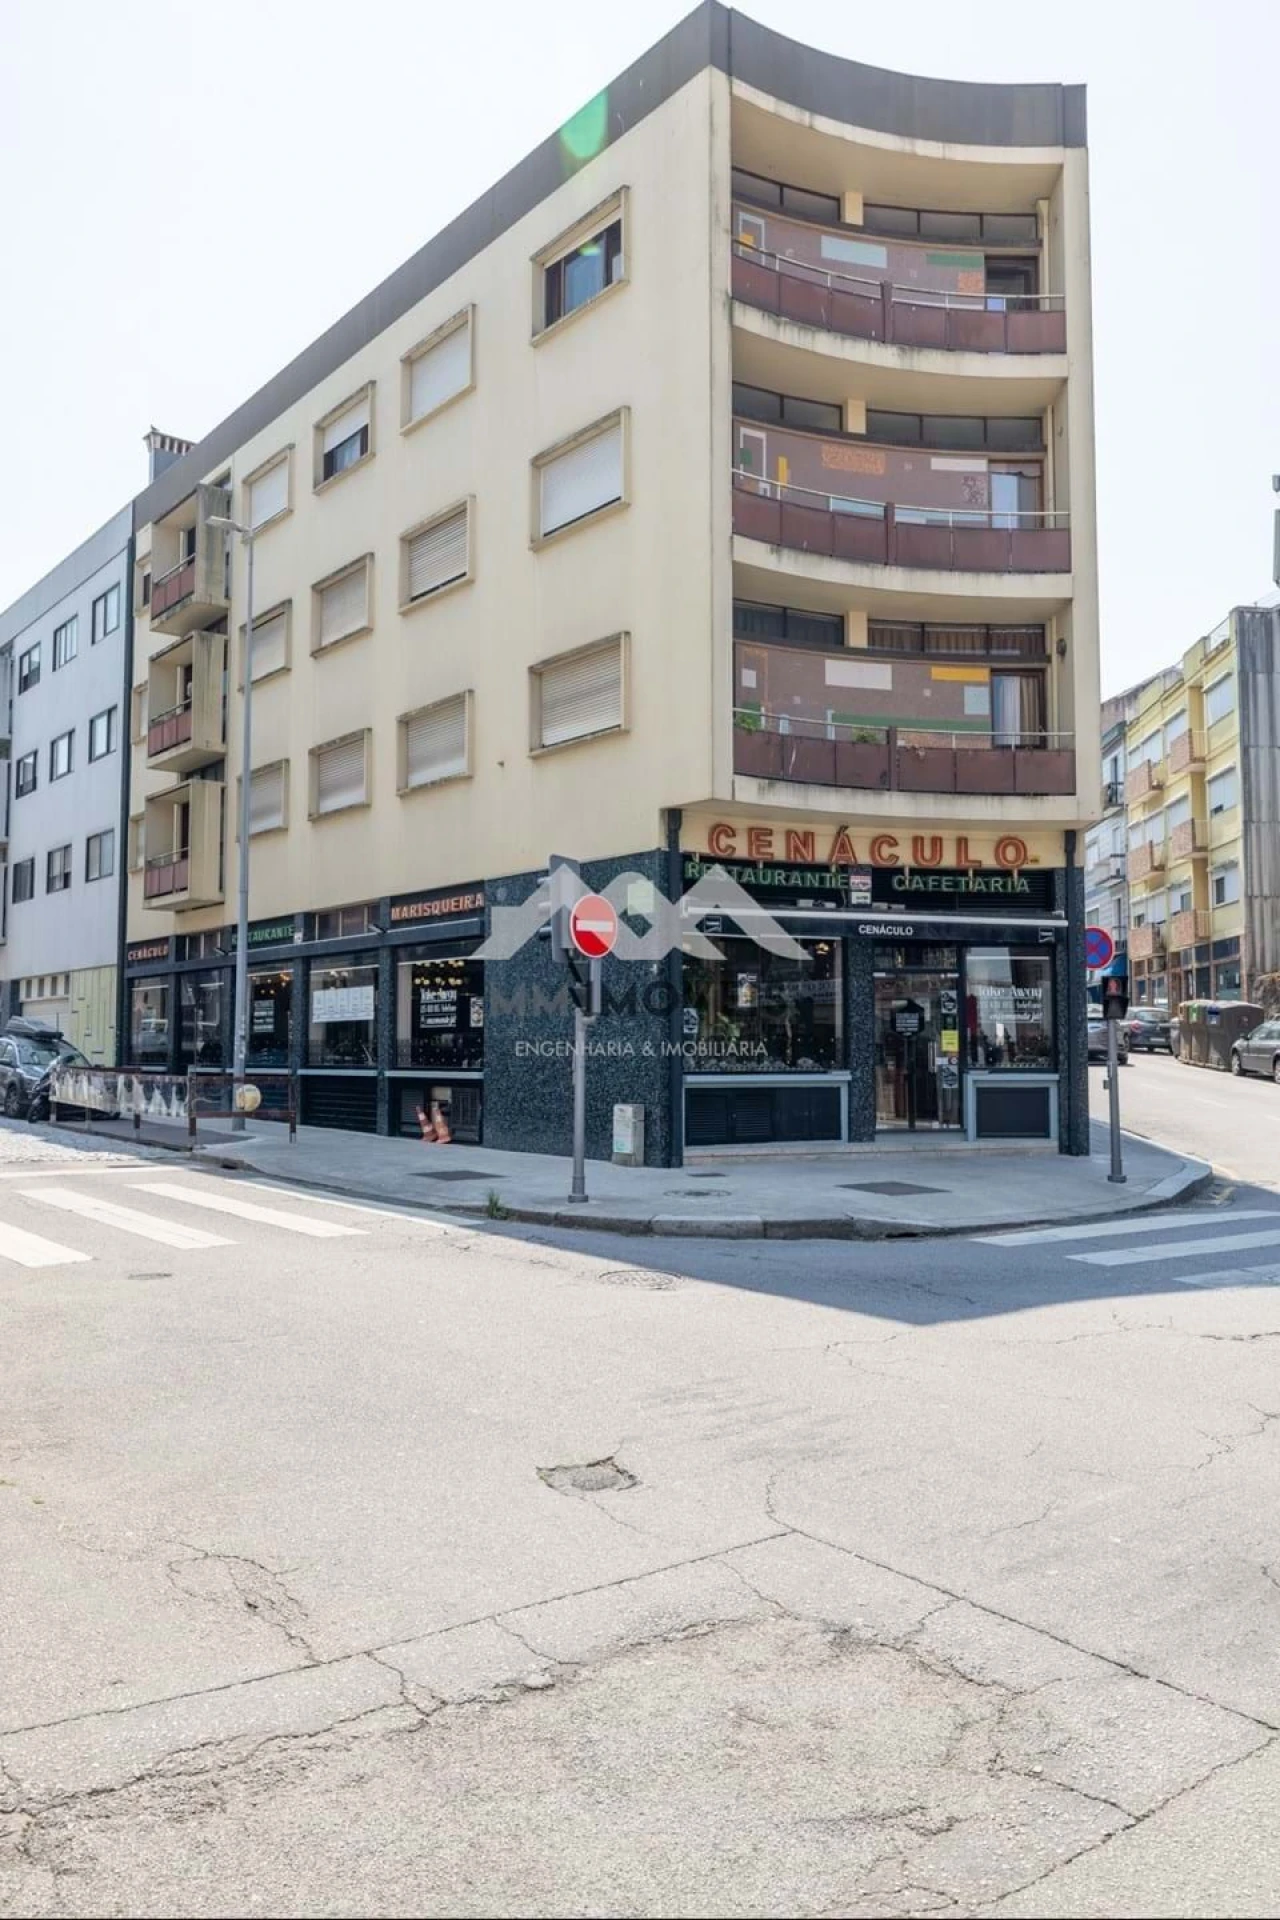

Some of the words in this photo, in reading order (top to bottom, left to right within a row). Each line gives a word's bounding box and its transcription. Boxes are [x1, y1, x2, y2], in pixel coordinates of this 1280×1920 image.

[707, 824, 1028, 869] CENÁCULO
[391, 892, 485, 921] MARISQUEIRA
[858, 923, 914, 937] CENÁCULO
